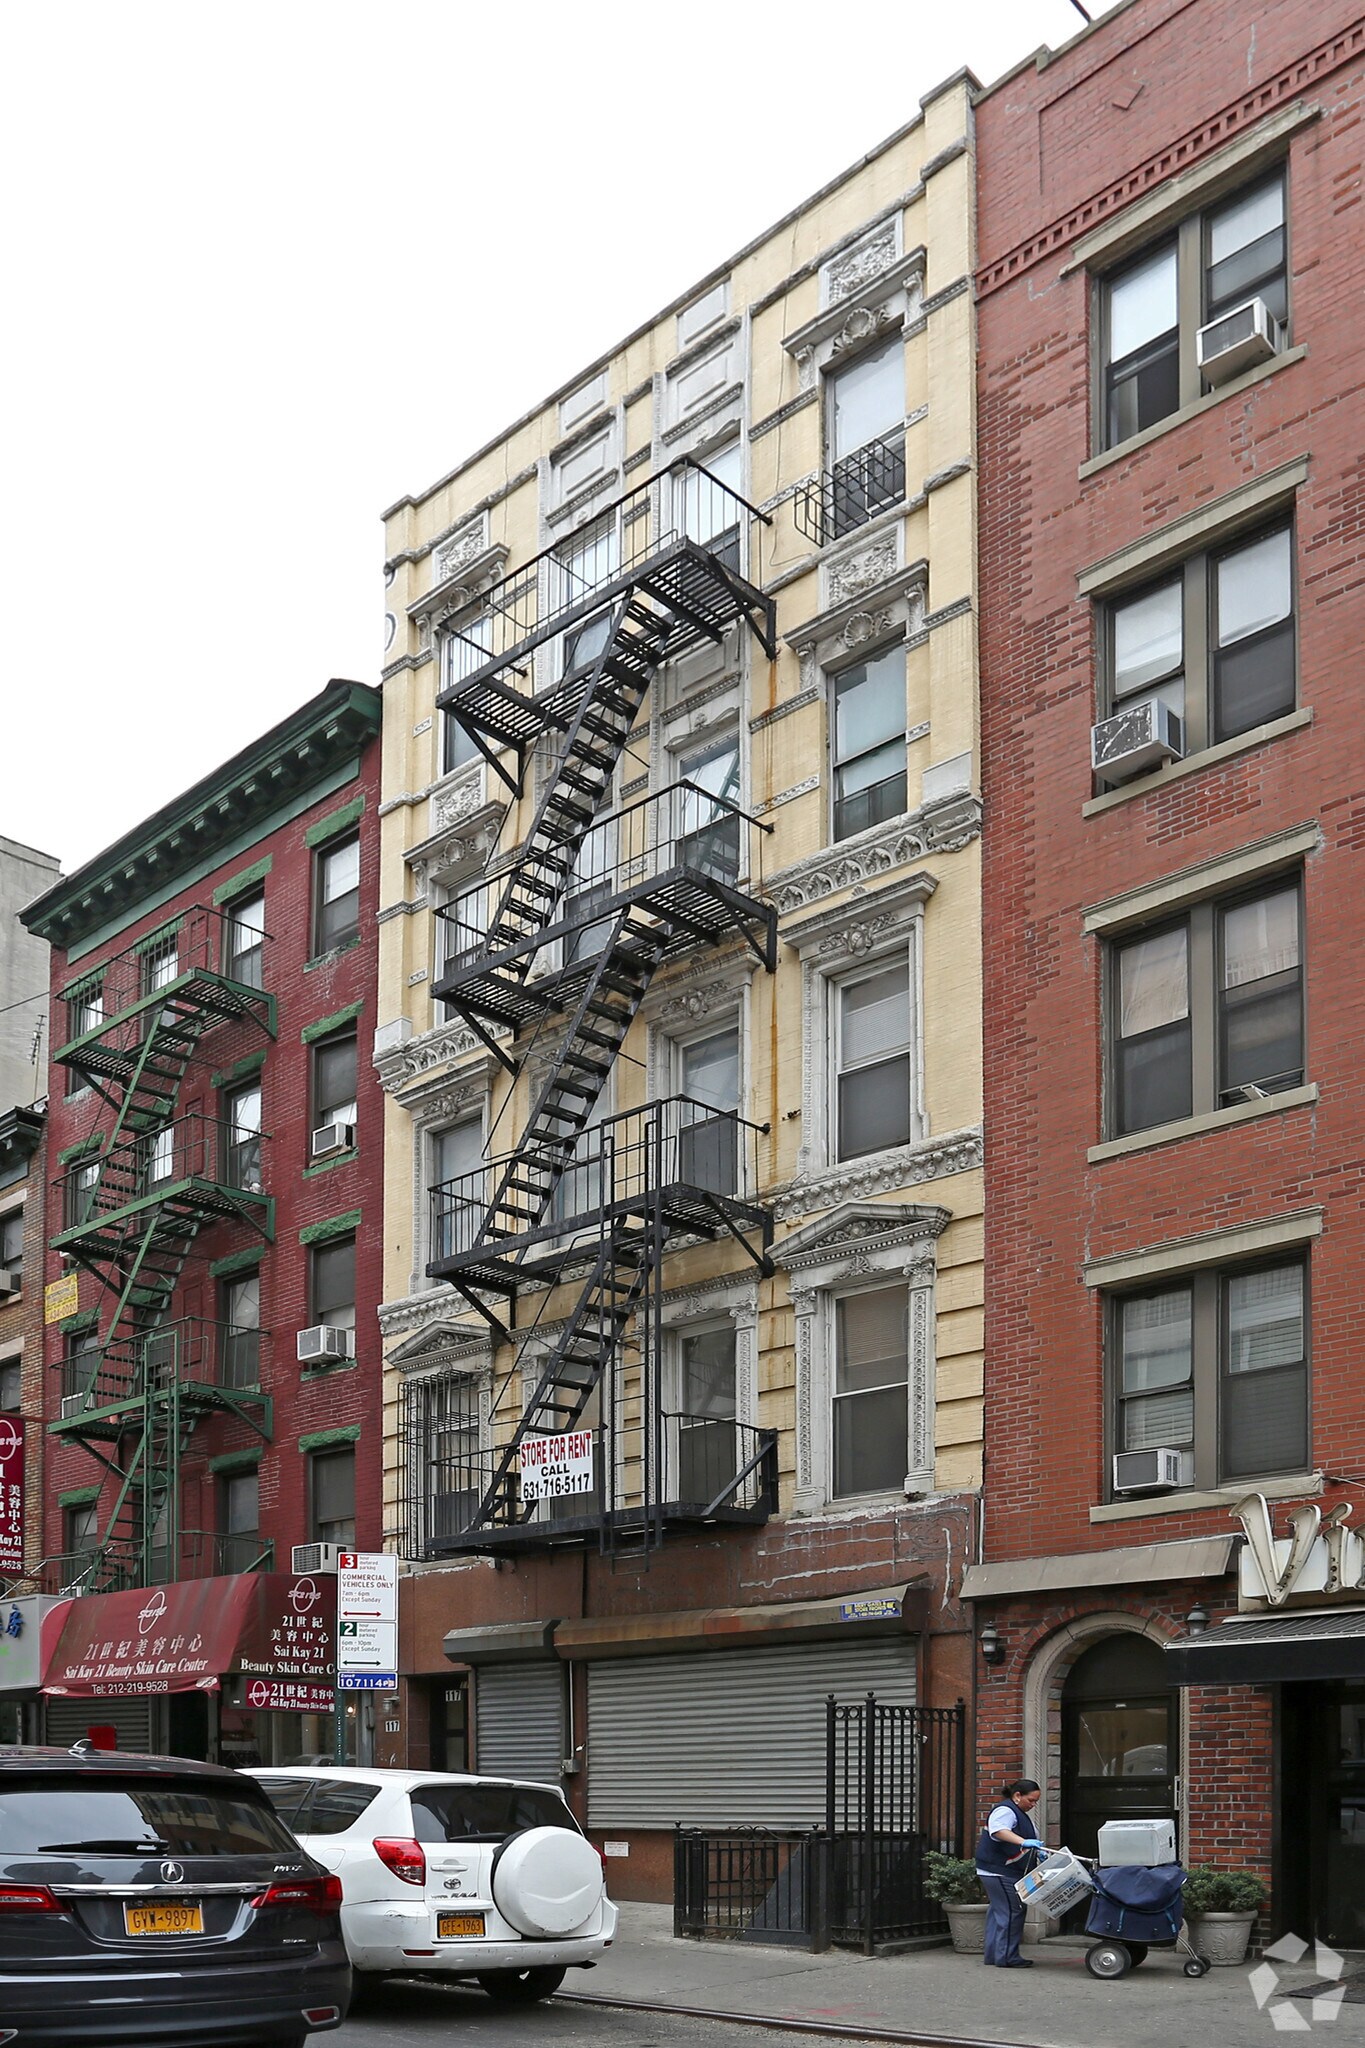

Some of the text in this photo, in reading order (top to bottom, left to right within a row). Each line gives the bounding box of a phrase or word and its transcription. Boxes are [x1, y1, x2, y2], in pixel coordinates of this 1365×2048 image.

[521, 1433, 591, 1467] STORE FOR RENT
[541, 1463, 570, 1477] CALL
[523, 1473, 590, 1499] 631-716-5117
[1228, 1493, 1365, 1606] Vi
[344, 1555, 354, 1568] 3
[343, 1623, 354, 1636] 2
[274, 1644, 324, 1660] Sai Kay 21
[64, 1665, 77, 1680] Sai
[94, 1665, 105, 1678] 21
[105, 1661, 134, 1680] Beauty
[133, 1660, 155, 1676] Skin
[155, 1659, 177, 1674] Care
[177, 1656, 208, 1673] Center
[240, 1658, 275, 1675] Beauty
[277, 1660, 299, 1674] Skin
[302, 1662, 324, 1674] Care
[91, 1680, 168, 1695] Tel: 212-219-9528
[341, 1678, 382, 1687] 107114
[311, 1688, 334, 1700] 美容中
[445, 1690, 461, 1701] 117
[290, 1698, 296, 1708] 21
[386, 1720, 399, 1732] 117
[1047, 1892, 1064, 1908] UNITED
